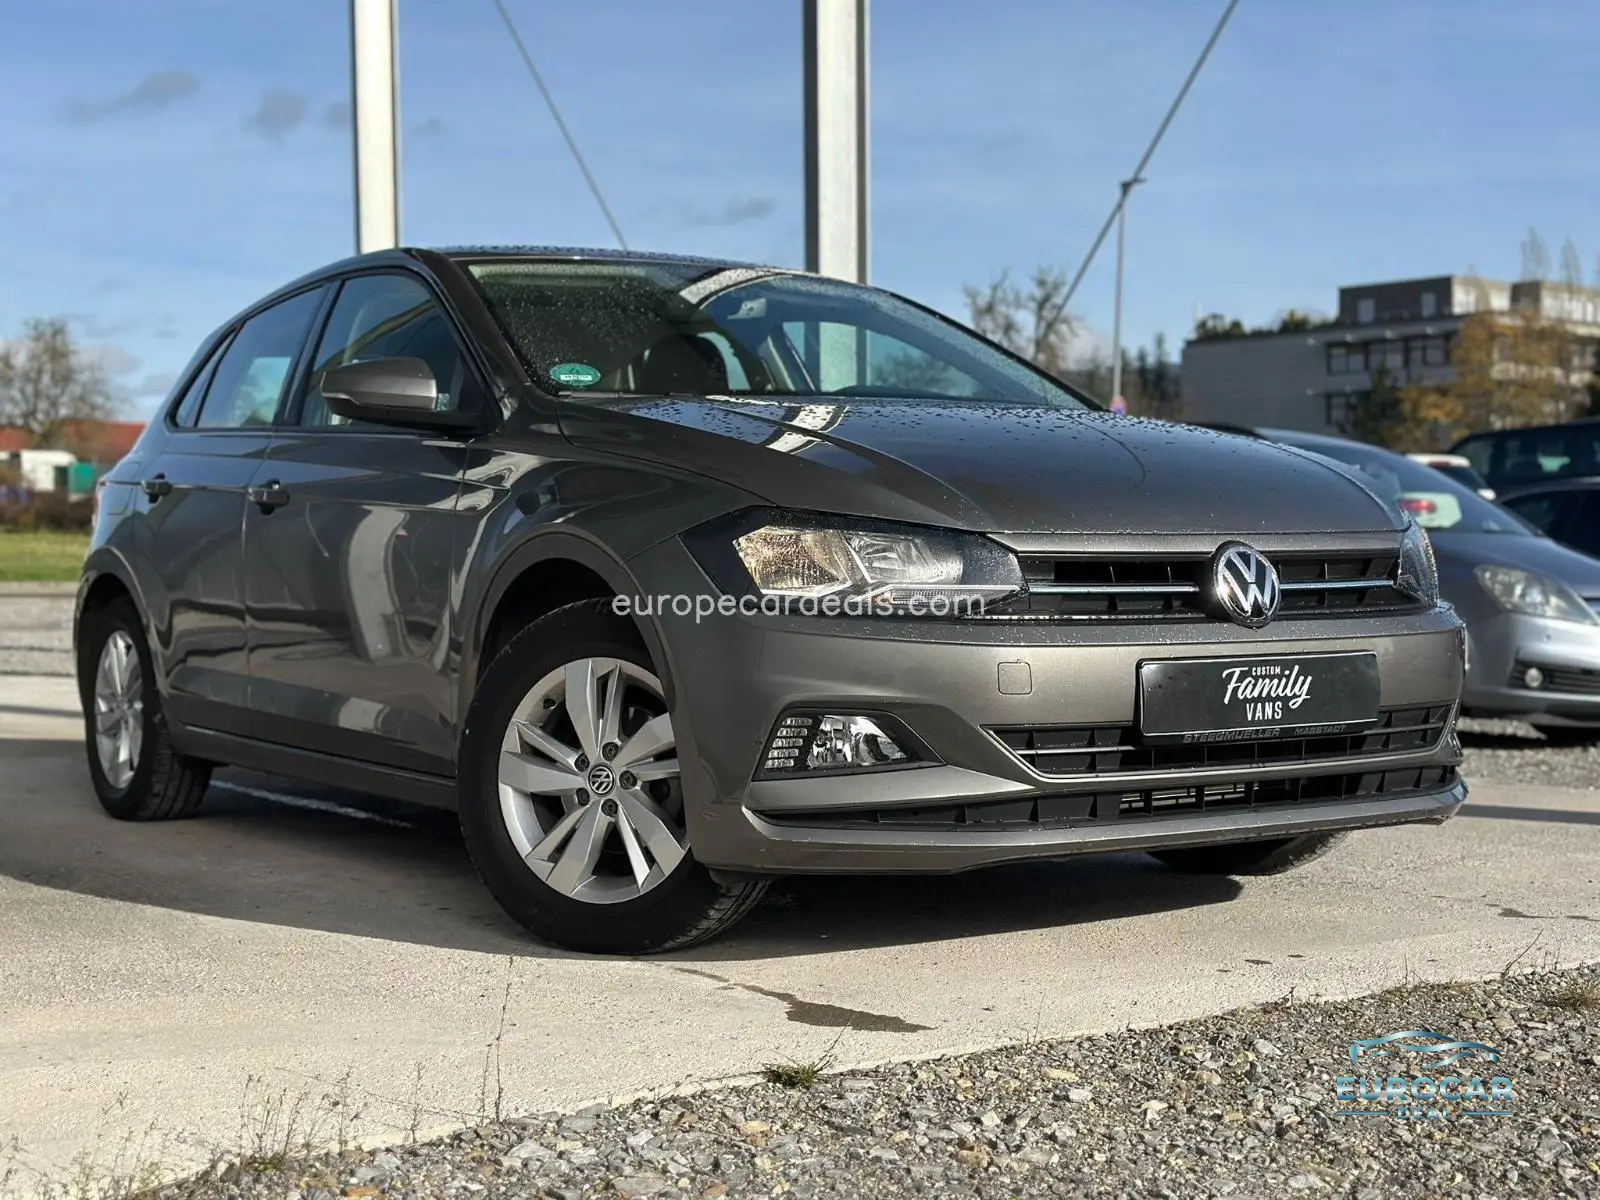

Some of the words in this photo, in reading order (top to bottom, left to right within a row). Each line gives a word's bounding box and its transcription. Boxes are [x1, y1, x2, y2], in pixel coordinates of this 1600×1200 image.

[1252, 665, 1281, 676] CUSTOM
[1222, 664, 1312, 709] Family
[1246, 701, 1283, 721] VANS
